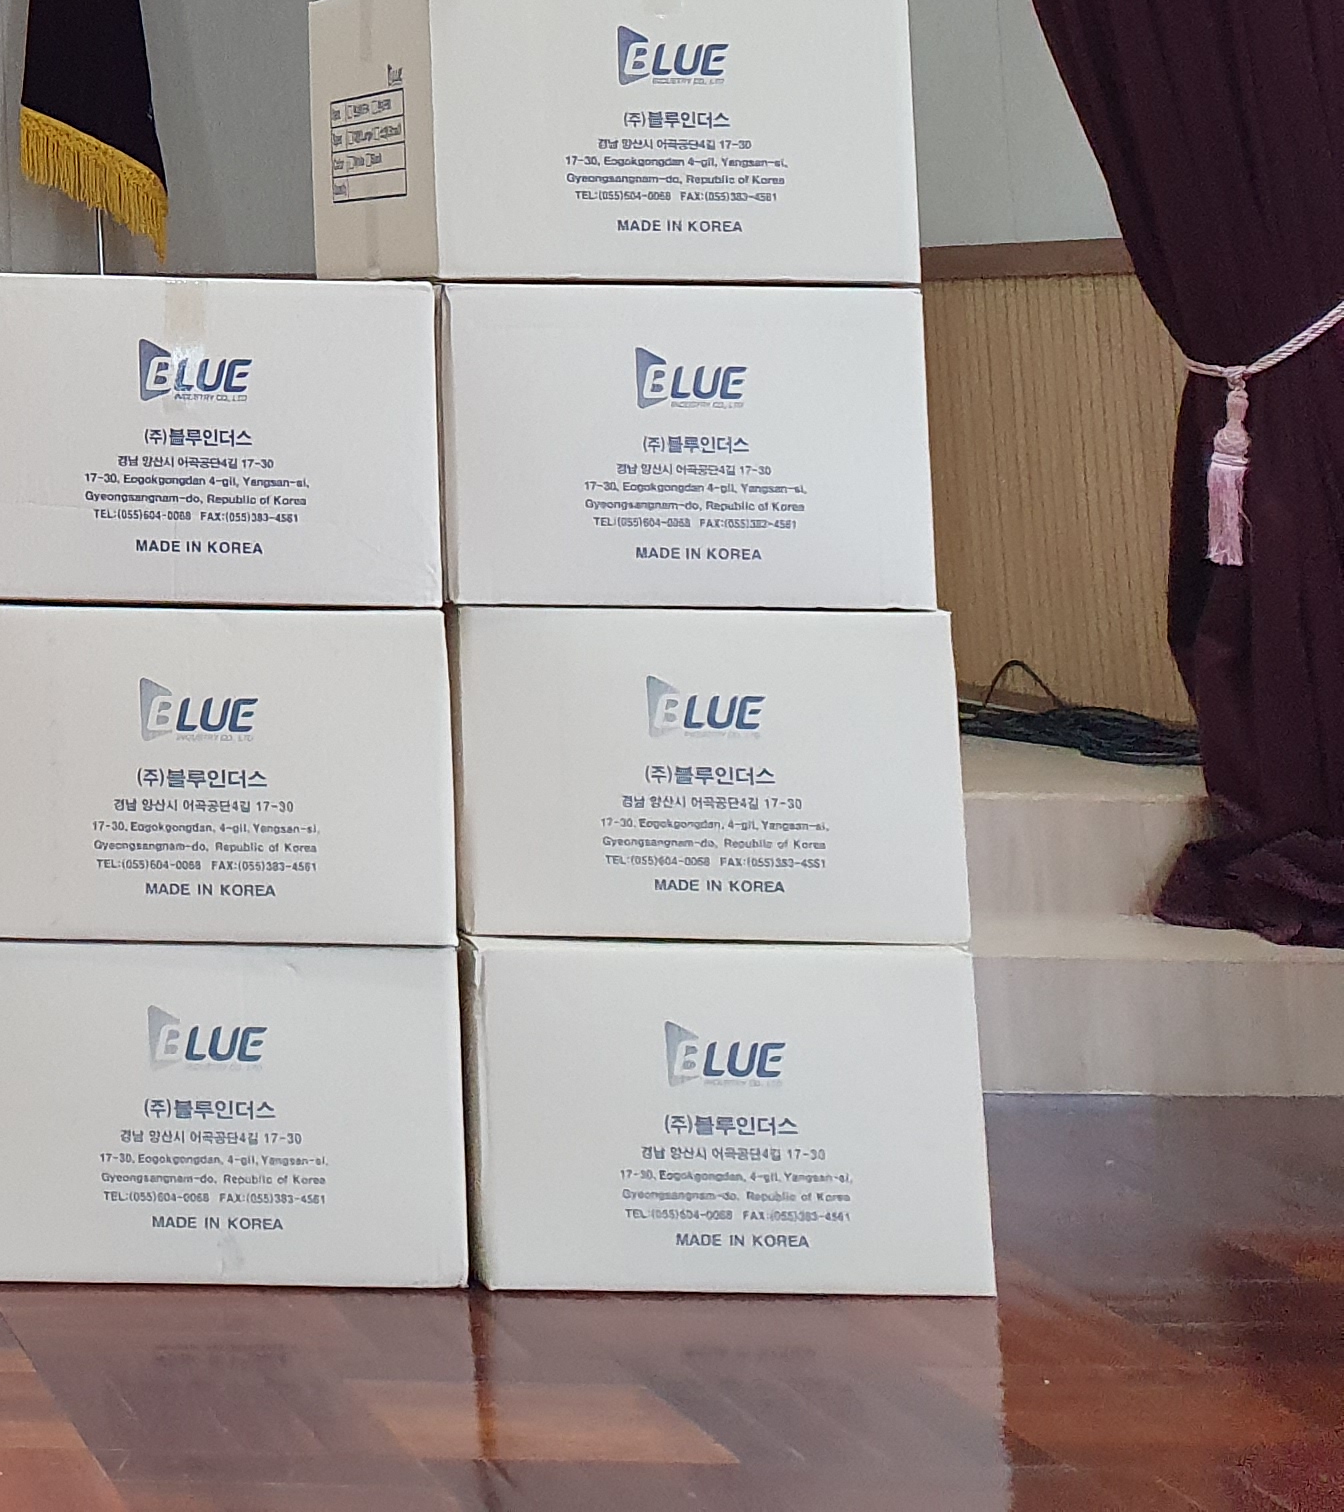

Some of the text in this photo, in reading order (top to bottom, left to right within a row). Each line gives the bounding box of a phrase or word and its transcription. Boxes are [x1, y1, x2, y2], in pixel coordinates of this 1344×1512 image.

[619, 33, 730, 80] BLUE
[616, 218, 743, 233] MADE IN KOREA
[140, 346, 253, 396] BLUE
[637, 355, 748, 403] BLUE
[143, 427, 254, 448] (주)블루인더스
[135, 536, 264, 555] MADE IN KOREA
[141, 685, 259, 735] BLUE
[648, 684, 767, 730] BLUE
[136, 767, 268, 790] (주)블루인더스
[644, 764, 776, 787] (주)블루인더스
[653, 878, 786, 894] MADE IN KOREA
[150, 1012, 268, 1064] BLUE
[666, 1029, 787, 1080] BLUE
[143, 1097, 277, 1121] (주)블루인더스
